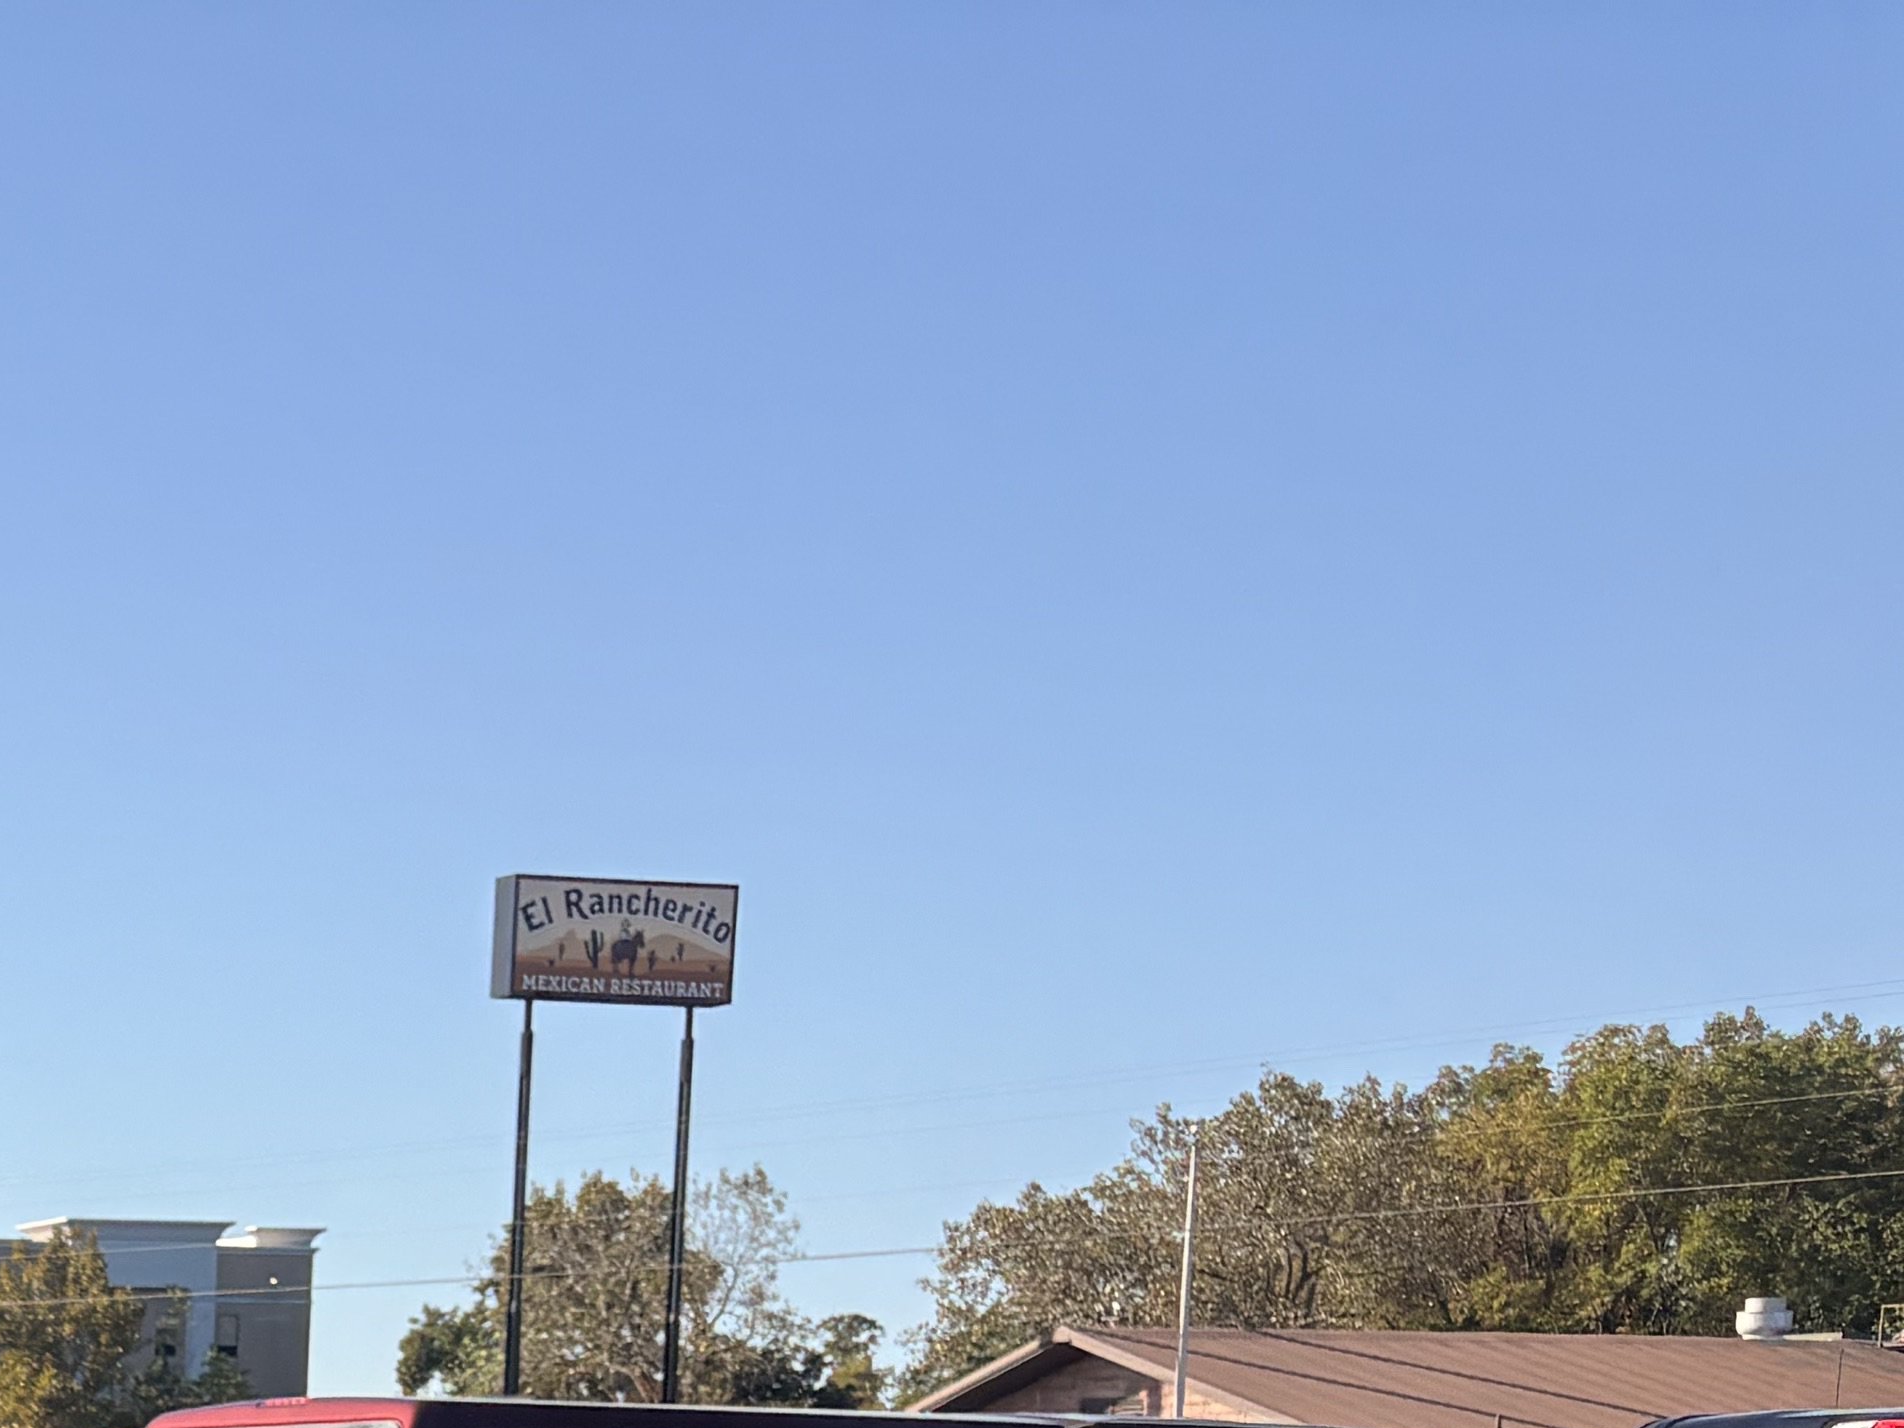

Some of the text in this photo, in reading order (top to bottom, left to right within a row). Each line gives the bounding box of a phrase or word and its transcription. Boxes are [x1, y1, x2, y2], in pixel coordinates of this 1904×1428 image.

[520, 887, 732, 945] El Rancherito
[522, 974, 724, 998] MEXICAN RESTAURANT
